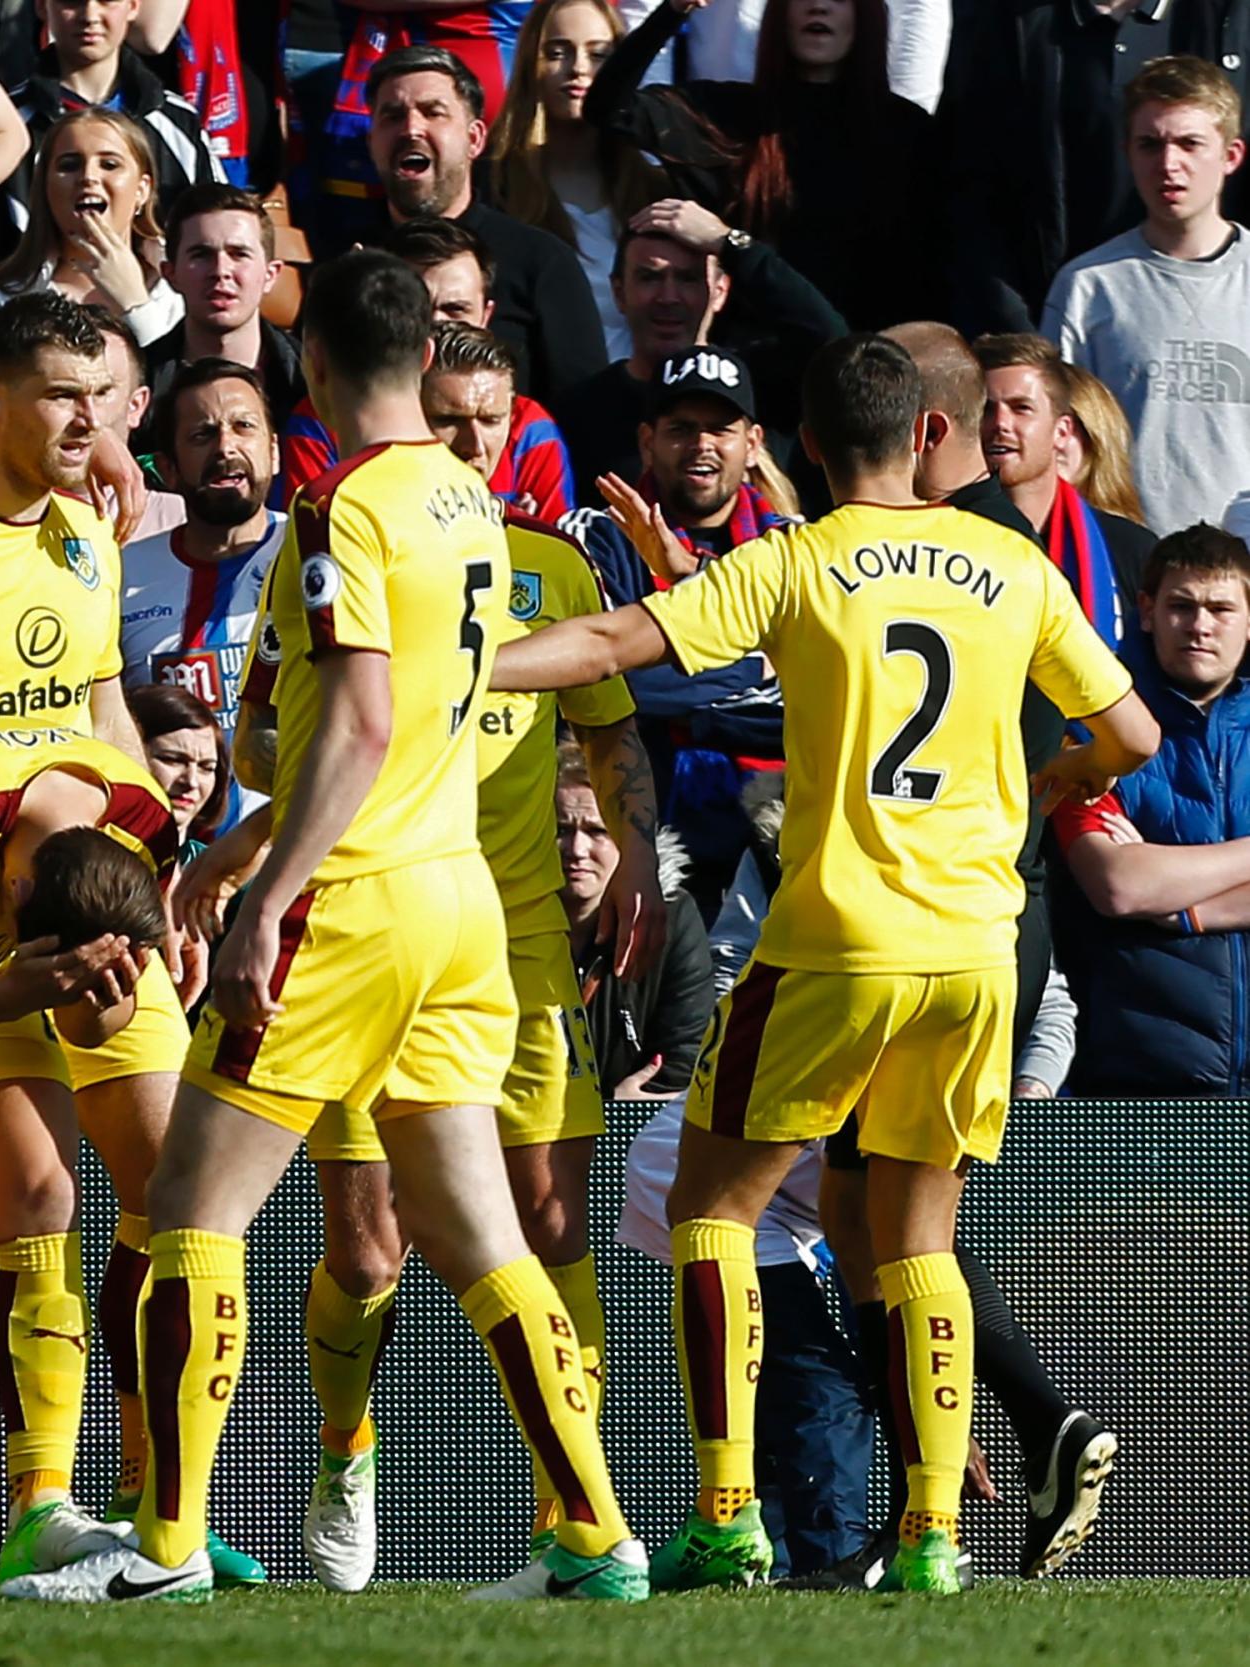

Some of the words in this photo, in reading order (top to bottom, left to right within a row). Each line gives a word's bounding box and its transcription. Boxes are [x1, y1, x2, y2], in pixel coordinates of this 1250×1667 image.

[1146, 360, 1214, 381] ORTH
[1153, 381, 1214, 402] FACE
[1165, 339, 1214, 360] THE
[828, 542, 1004, 608] LOWTON
[450, 561, 493, 736] 5
[869, 619, 952, 802] 2
[208, 1292, 237, 1402] BFC
[546, 1312, 587, 1413] BFC
[928, 1316, 959, 1411] BFC
